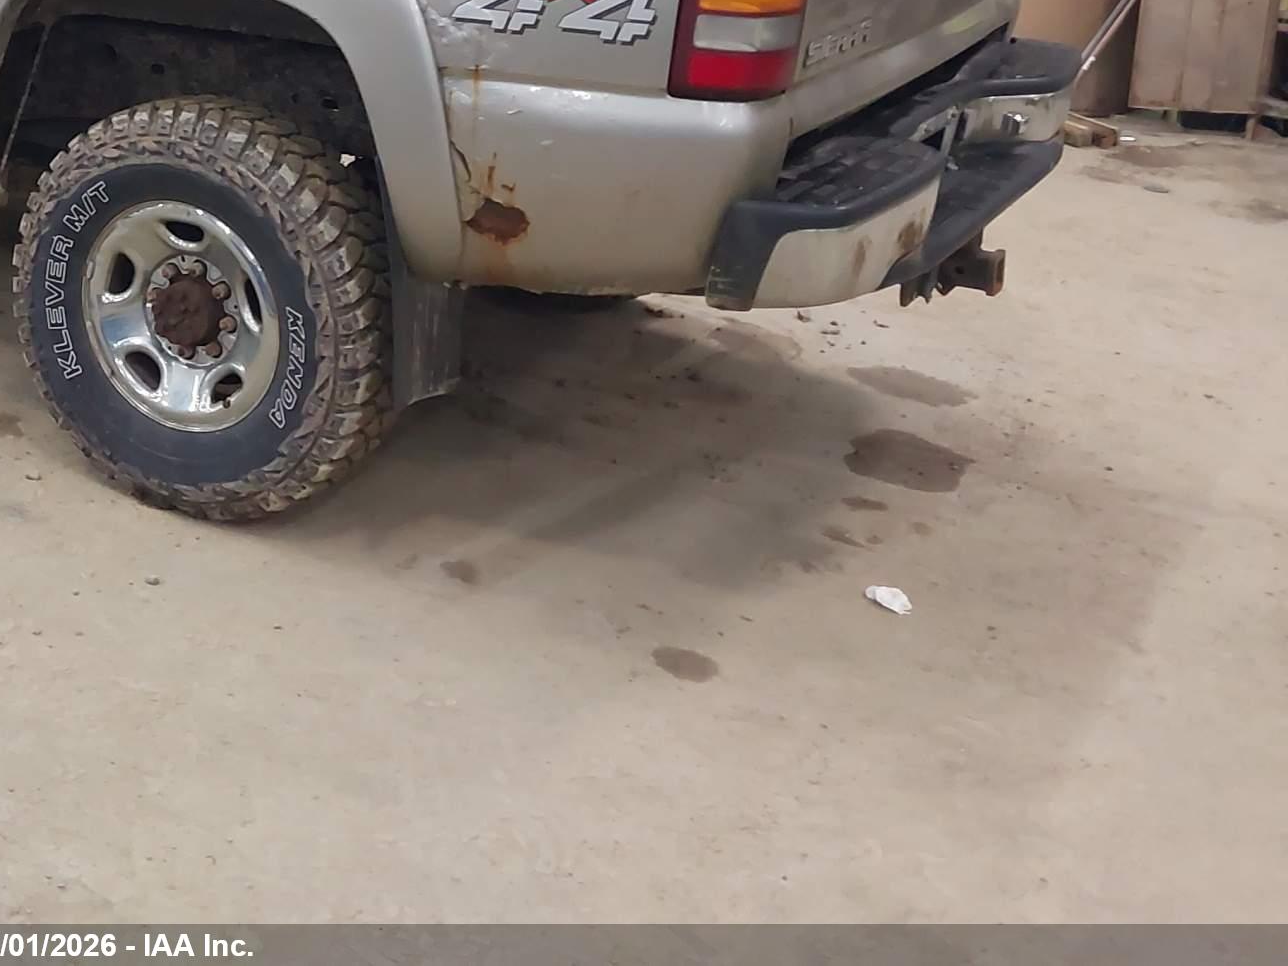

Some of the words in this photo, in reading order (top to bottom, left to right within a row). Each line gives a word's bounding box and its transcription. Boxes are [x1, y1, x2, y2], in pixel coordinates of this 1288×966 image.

[62, 180, 111, 233] M/T
[44, 234, 83, 380] KLEVER
[268, 306, 306, 429] KENDA
